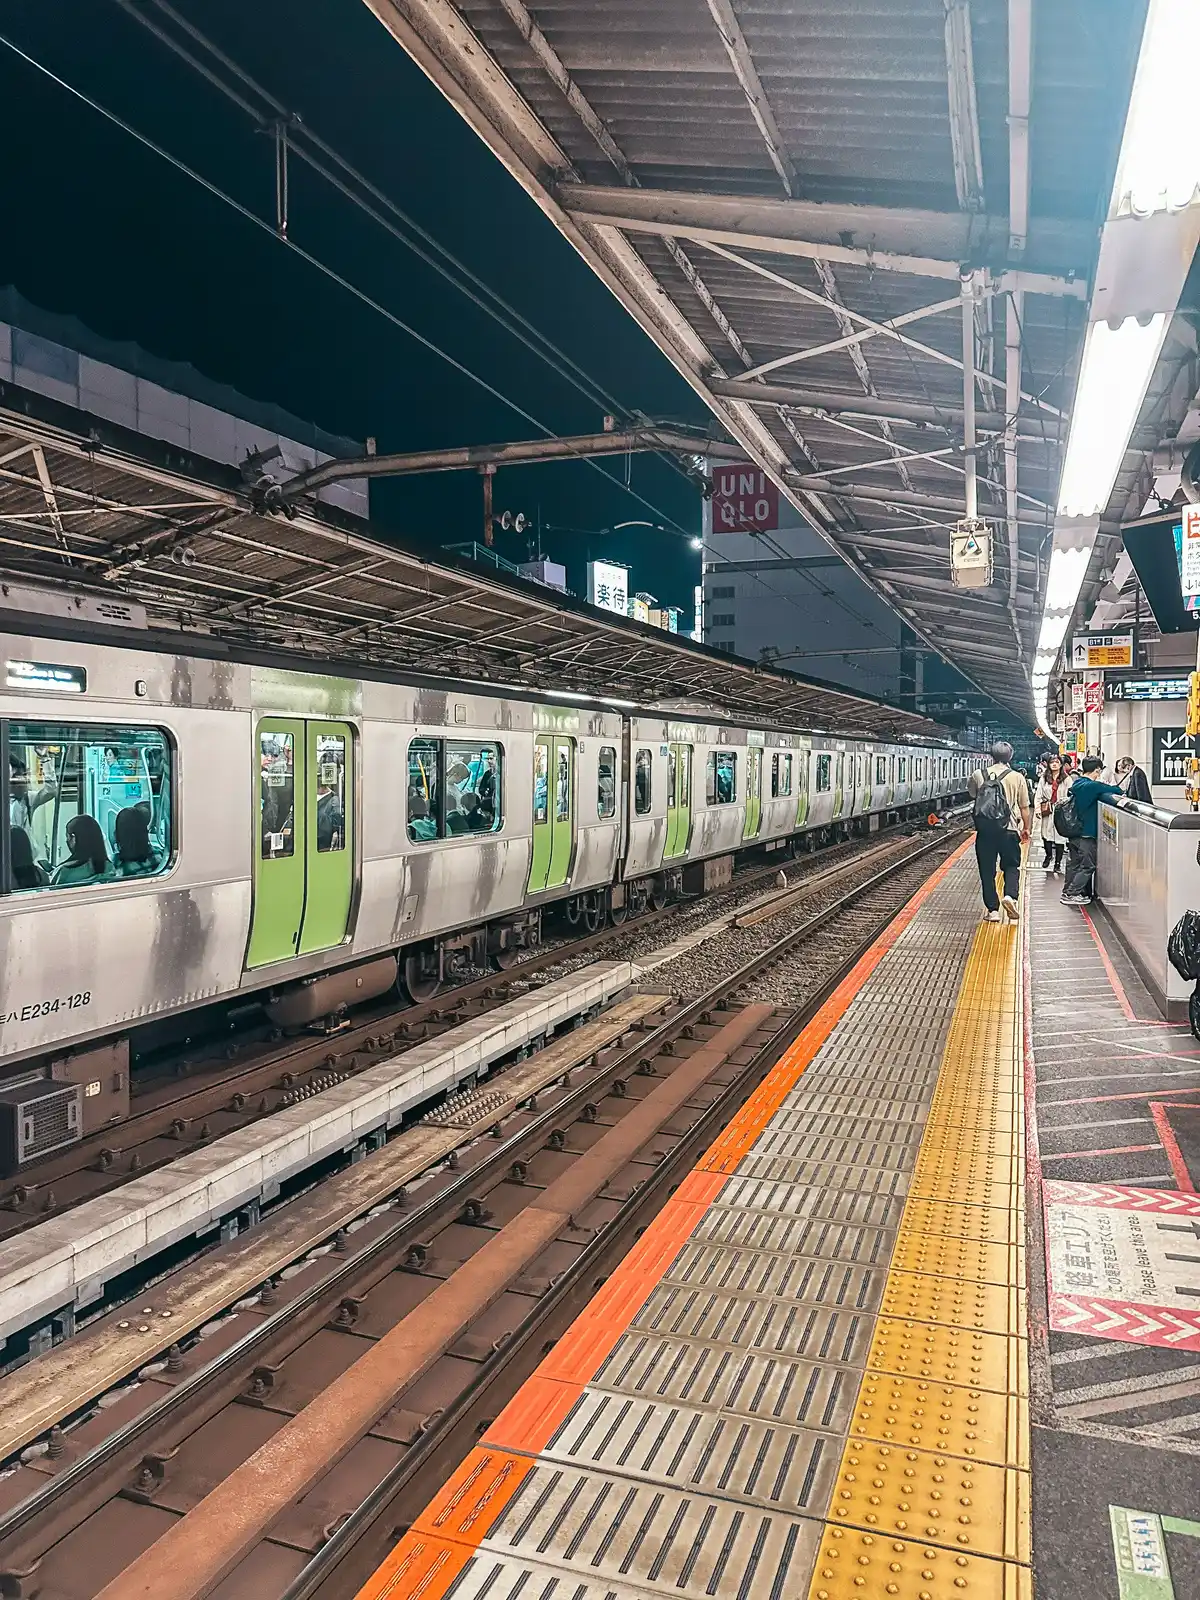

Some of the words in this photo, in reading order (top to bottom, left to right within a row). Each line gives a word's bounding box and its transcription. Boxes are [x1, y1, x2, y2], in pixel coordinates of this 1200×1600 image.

[721, 473, 765, 496] UNI
[721, 500, 769, 527] QLO
[597, 583, 625, 610] 楽待
[1107, 683, 1123, 699] 14
[1061, 1211, 1099, 1288] 降車エリア
[1128, 1233, 1145, 1247] this
[1135, 1248, 1151, 1268] leave
[1140, 1269, 1158, 1297] Please
